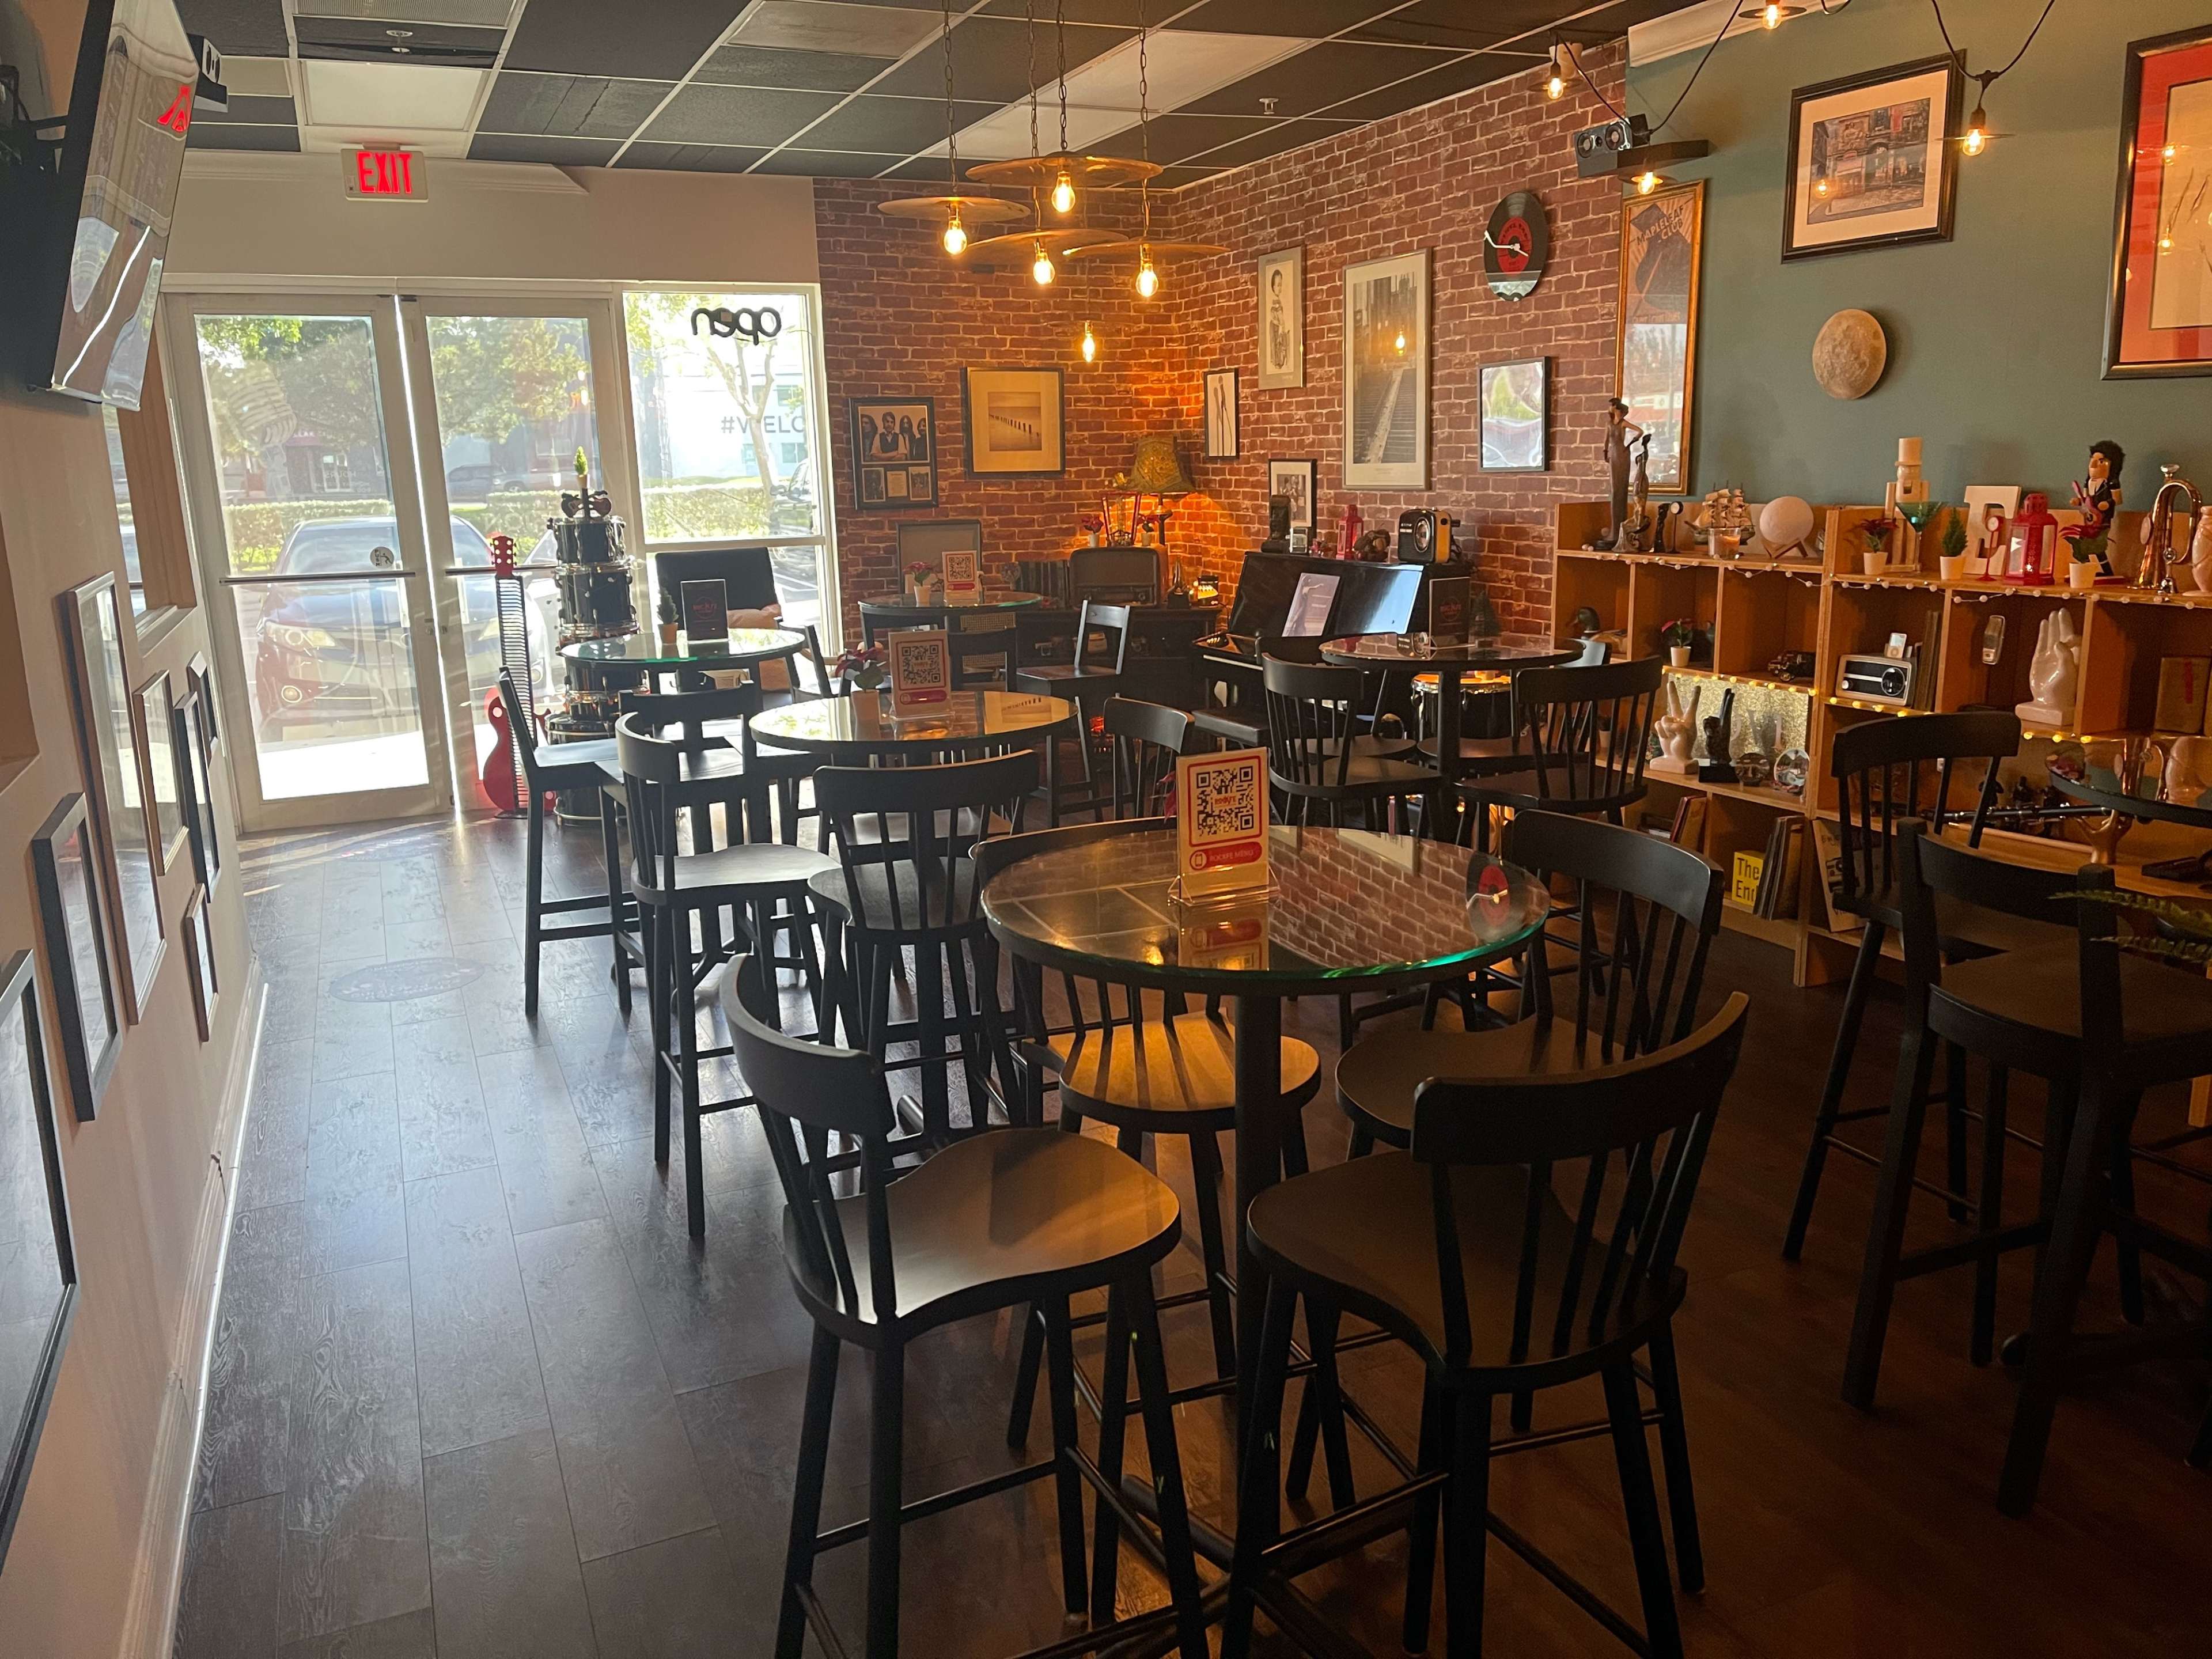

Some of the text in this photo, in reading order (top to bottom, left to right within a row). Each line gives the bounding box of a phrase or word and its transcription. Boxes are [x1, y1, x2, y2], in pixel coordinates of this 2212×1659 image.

[357, 151, 412, 194] EXIT
[1636, 204, 1684, 246] MAPLELEAF
[1661, 218, 1683, 240] CLUB
[1234, 849, 1254, 858] MENU
[1737, 857, 1760, 880] The
